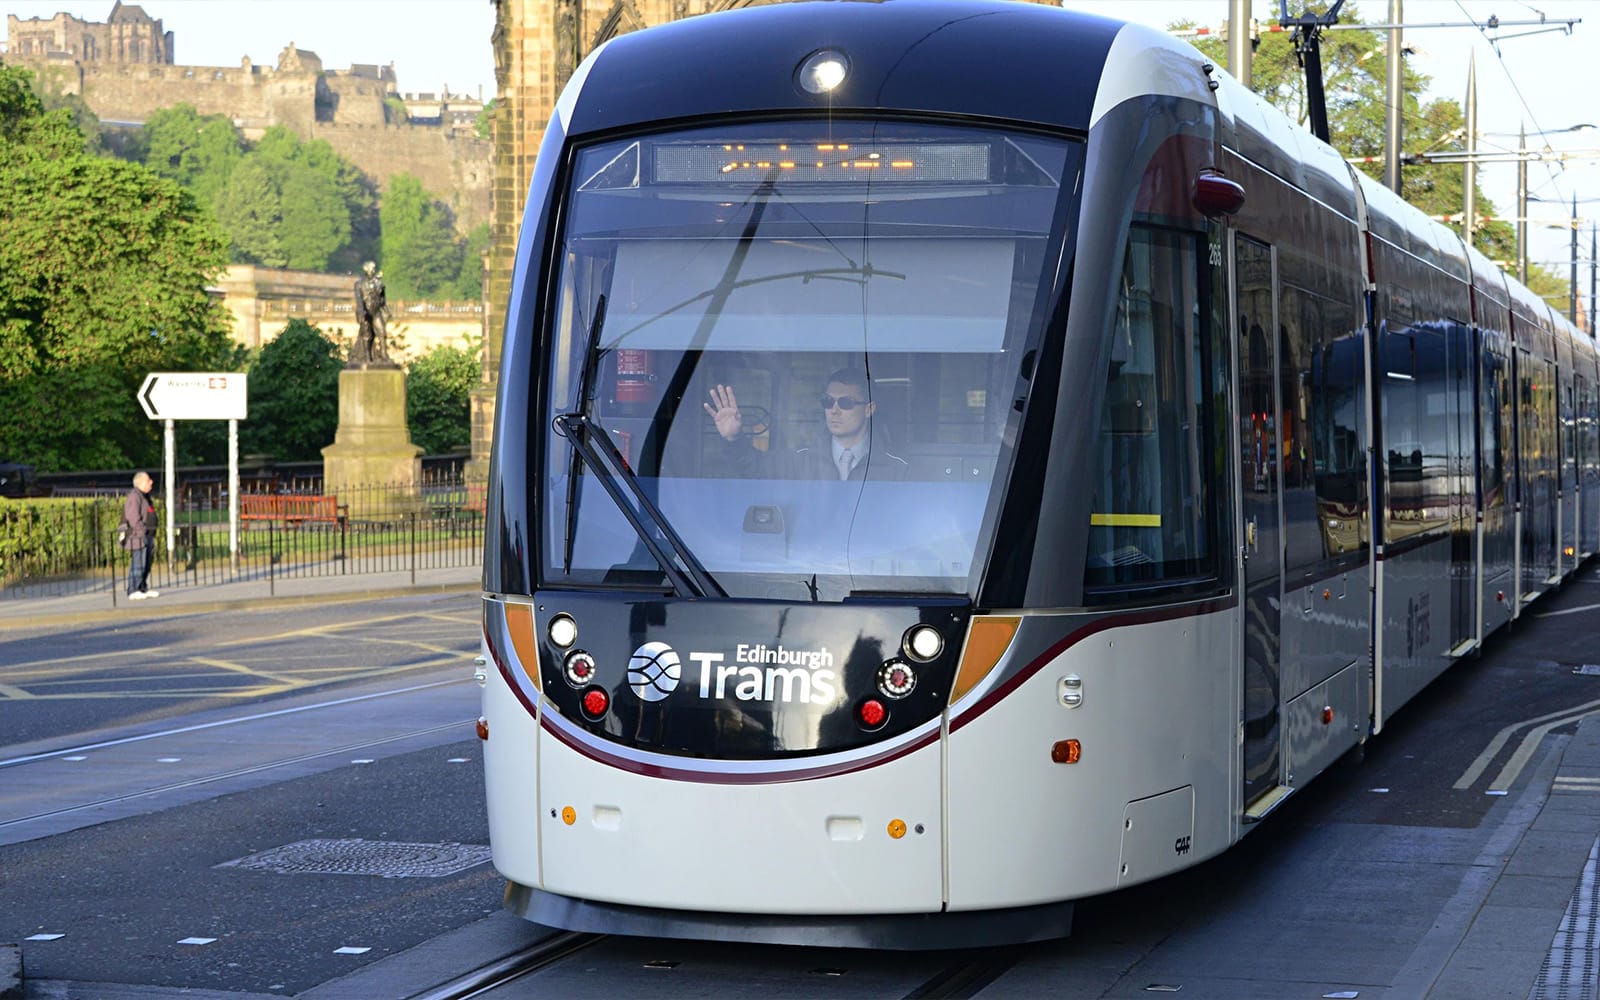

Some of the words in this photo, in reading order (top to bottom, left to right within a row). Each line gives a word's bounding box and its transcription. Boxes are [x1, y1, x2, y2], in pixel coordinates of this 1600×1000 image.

[1209, 243, 1221, 267] 265
[736, 644, 833, 668] Edinburgh
[689, 652, 836, 704] Trams
